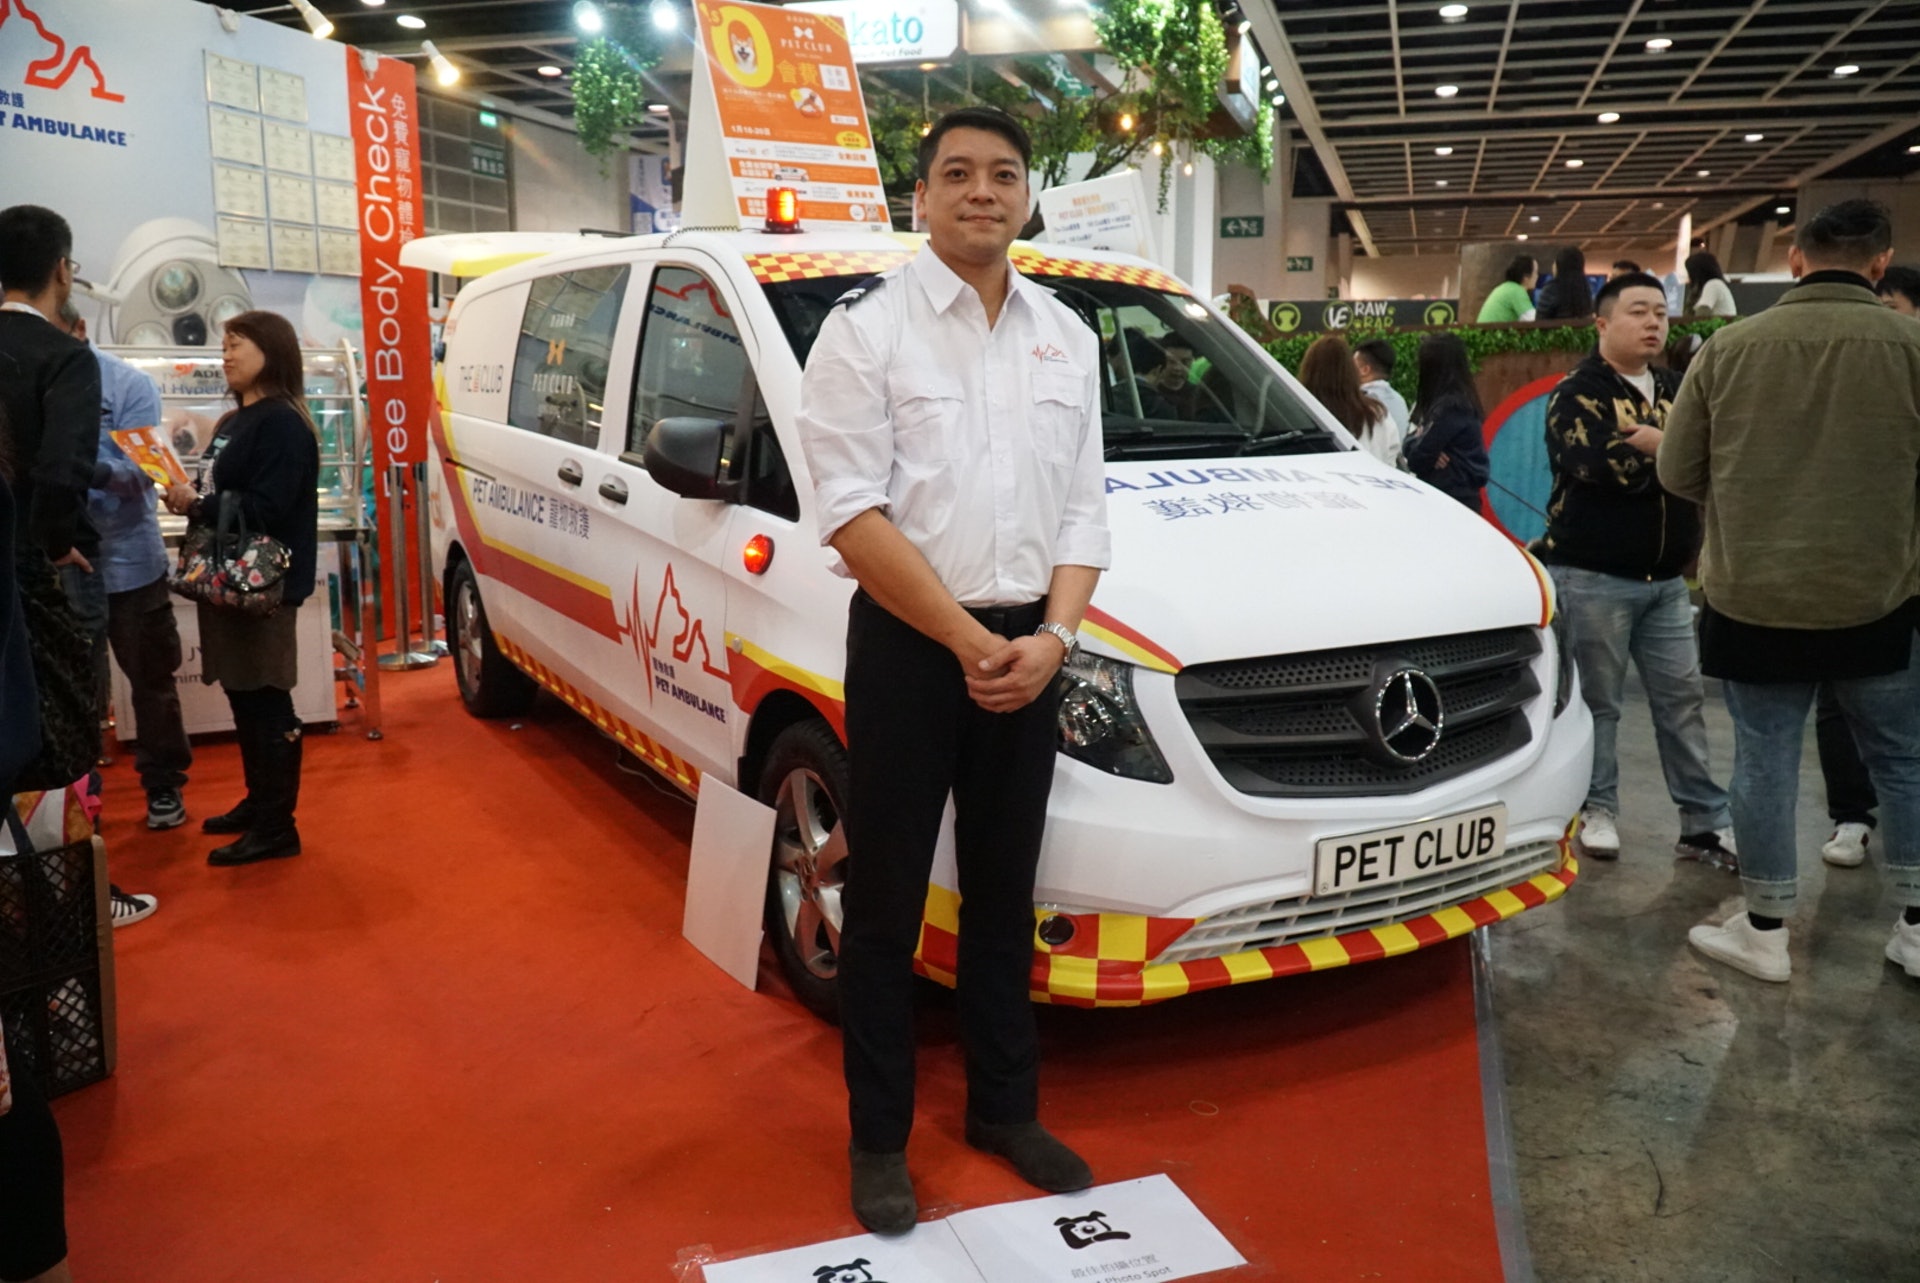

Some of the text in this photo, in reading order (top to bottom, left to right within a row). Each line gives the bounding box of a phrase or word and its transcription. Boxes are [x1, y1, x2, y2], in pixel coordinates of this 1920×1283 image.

[803, 41, 832, 53] CLUB
[12, 113, 127, 147] AMBULANCE
[358, 83, 395, 243] Check
[370, 257, 404, 381] Body
[1354, 301, 1388, 316] RAW
[473, 478, 545, 524] PET AMBULANCE
[655, 675, 727, 724] PET AMBULANCE
[1334, 815, 1496, 888] PET CLUB
[1143, 1265, 1173, 1280] Spot
